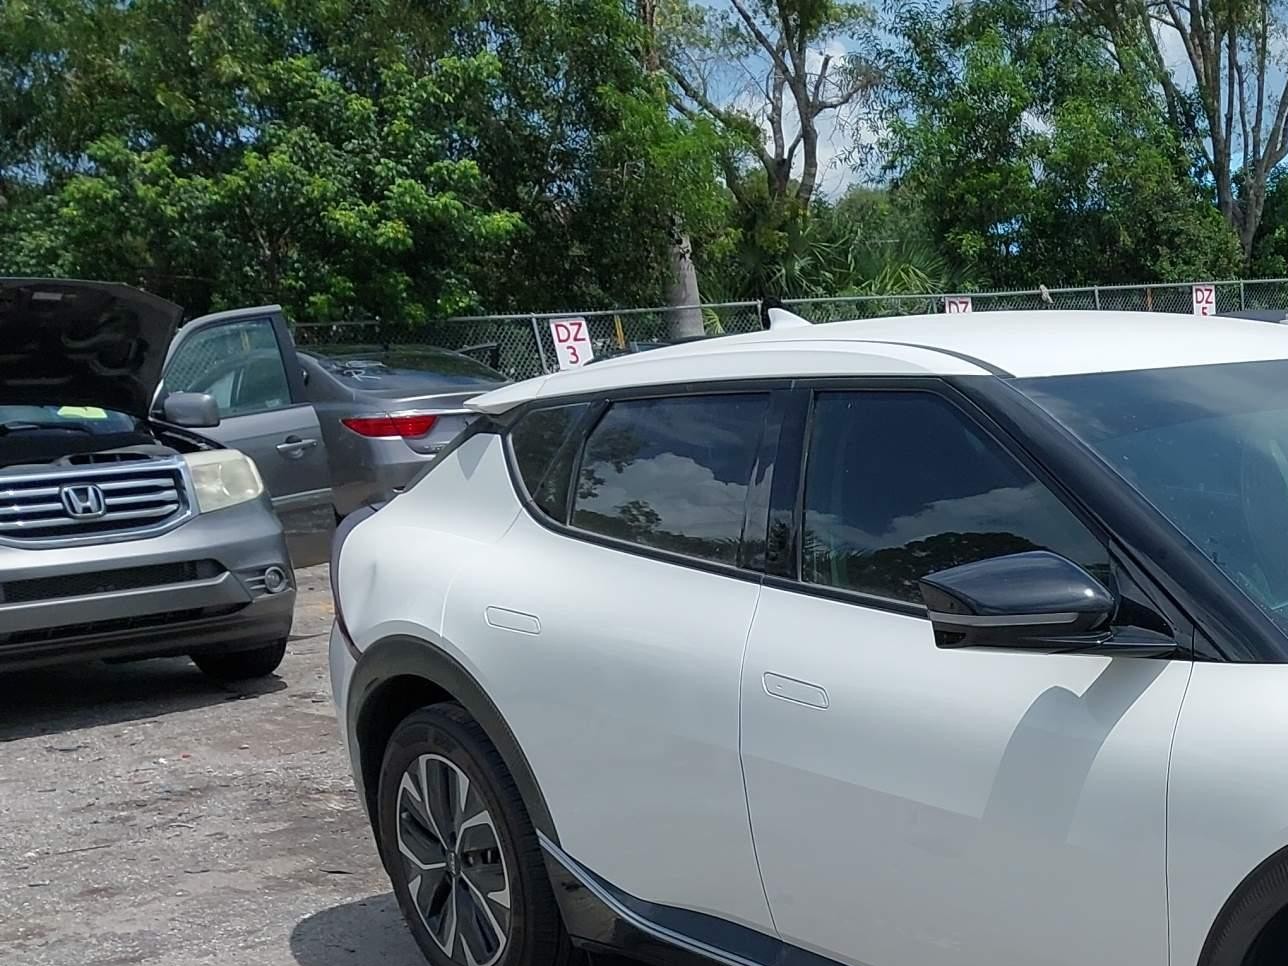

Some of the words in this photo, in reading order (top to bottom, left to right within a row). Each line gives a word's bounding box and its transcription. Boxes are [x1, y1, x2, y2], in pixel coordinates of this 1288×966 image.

[1195, 288, 1213, 304] DZ
[554, 322, 586, 343] DZ
[566, 346, 580, 364] 3
